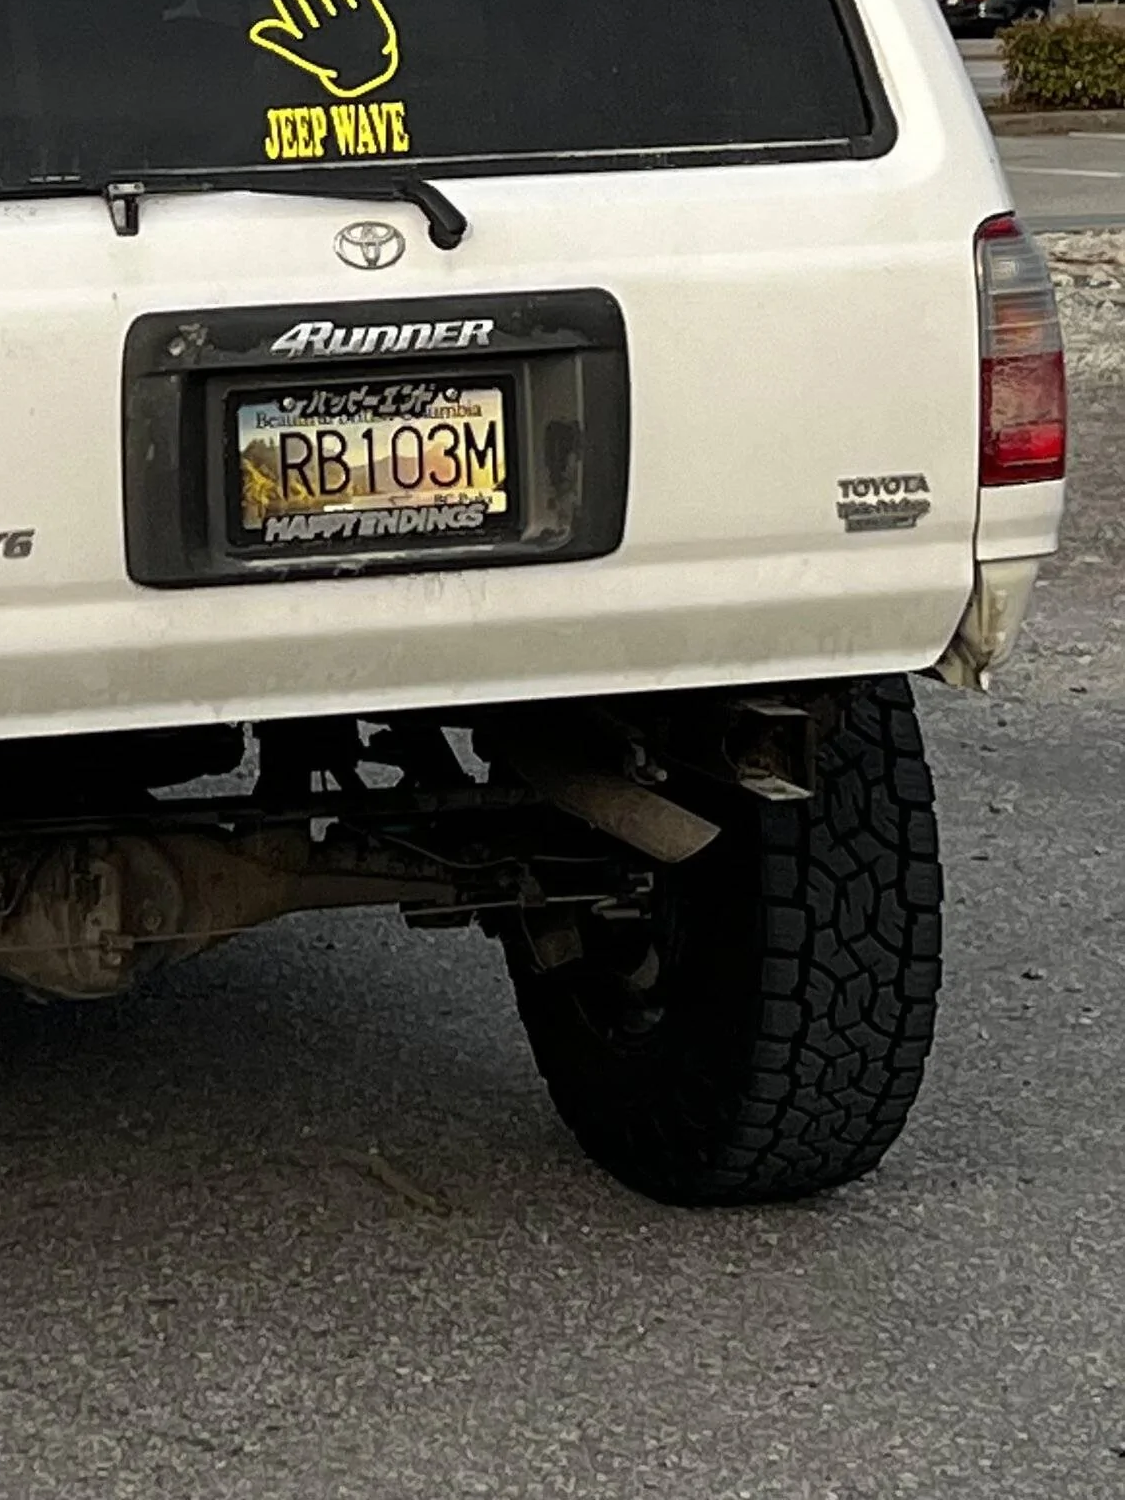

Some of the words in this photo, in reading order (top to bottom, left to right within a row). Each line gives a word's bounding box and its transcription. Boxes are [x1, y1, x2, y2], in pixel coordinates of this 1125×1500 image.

[265, 106, 327, 160] JEEP
[330, 102, 409, 156] WAVE
[278, 421, 499, 500] RB103M
[837, 474, 931, 498] TOYOTA
